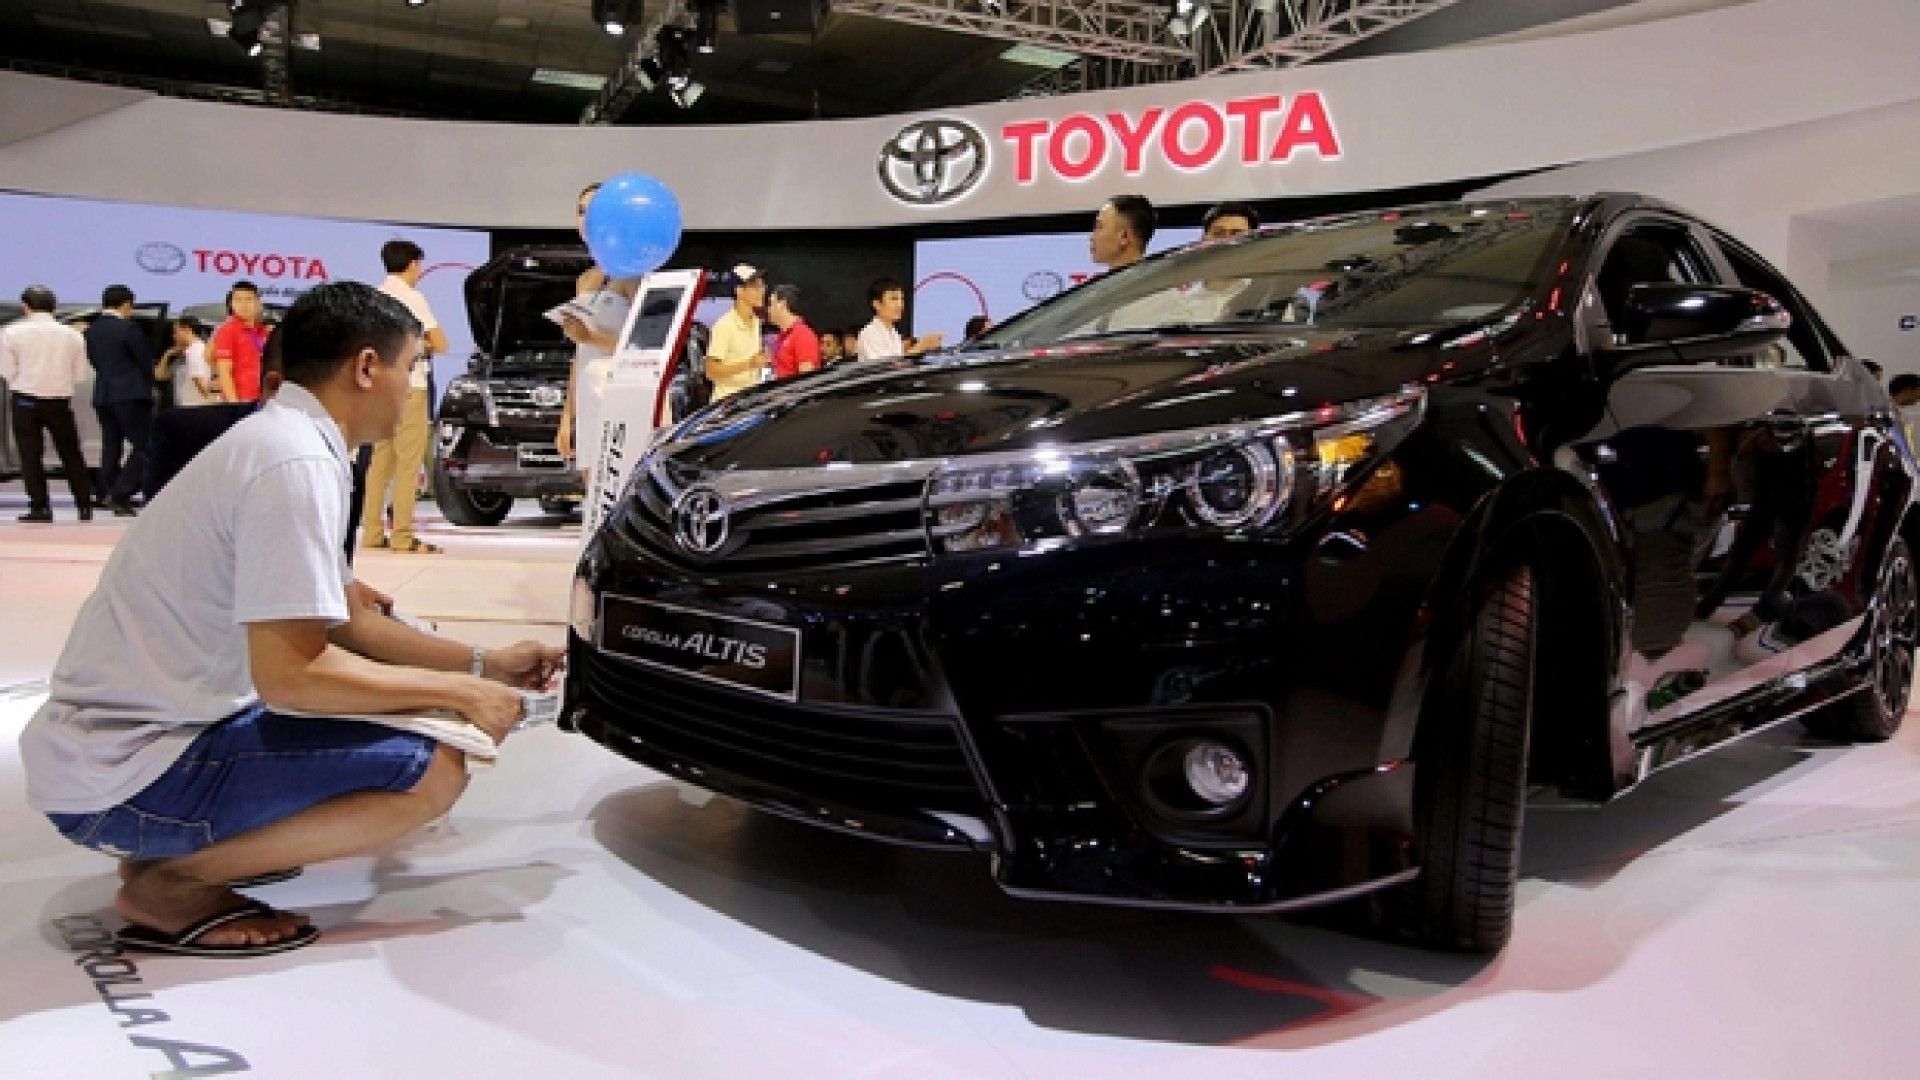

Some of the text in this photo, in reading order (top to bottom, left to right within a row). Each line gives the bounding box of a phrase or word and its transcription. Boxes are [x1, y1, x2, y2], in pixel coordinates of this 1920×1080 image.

[1003, 91, 1341, 183] TOYOTA
[192, 249, 328, 281] TOYOTA
[681, 631, 767, 669] ALTIS
